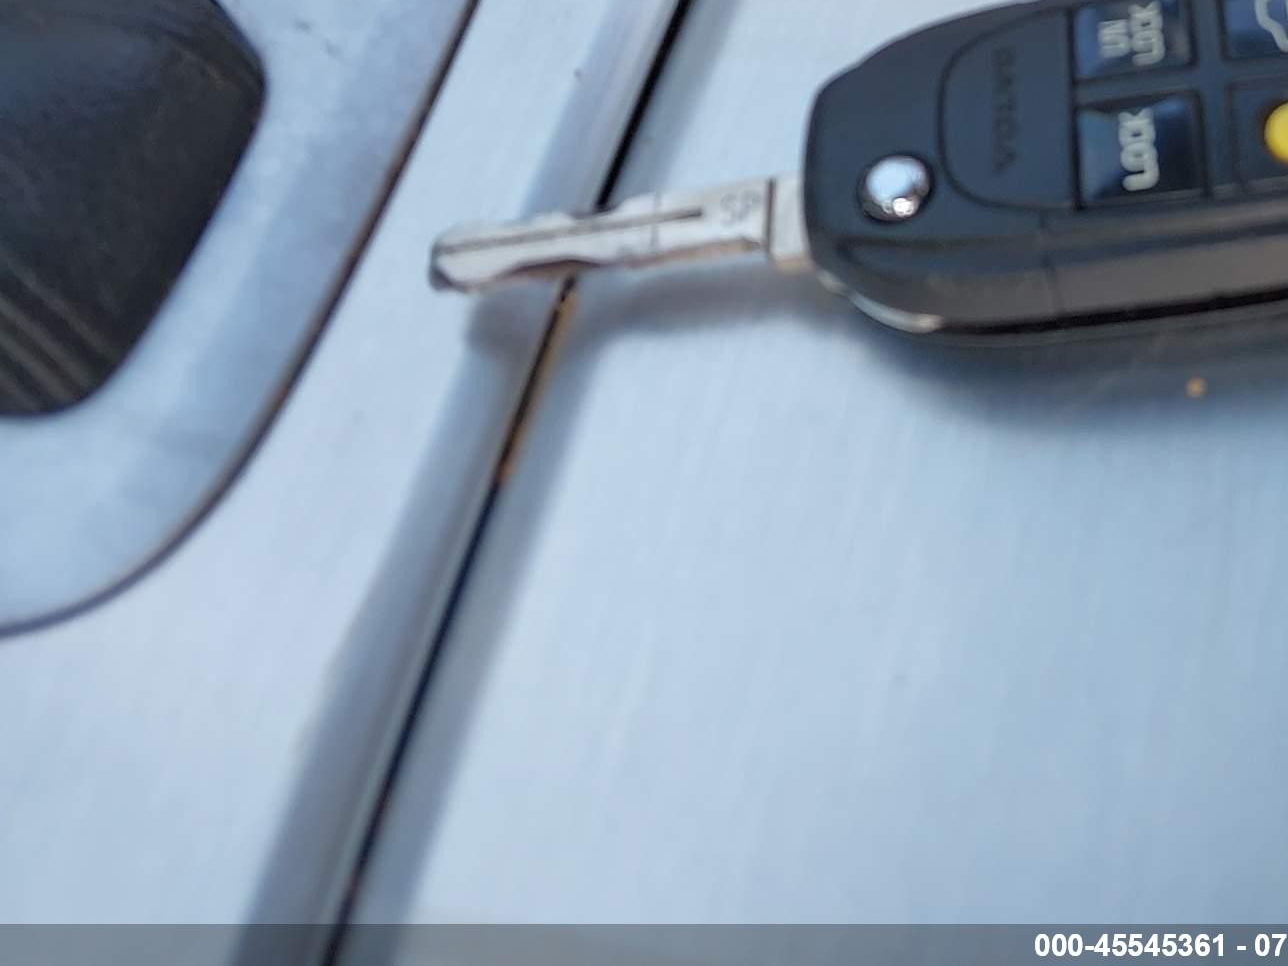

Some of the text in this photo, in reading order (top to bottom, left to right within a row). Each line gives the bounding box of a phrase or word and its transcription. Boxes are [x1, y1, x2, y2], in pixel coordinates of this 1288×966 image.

[1098, 19, 1129, 59] UN
[1128, 0, 1165, 67] LOCK
[991, 47, 1018, 174] VOLVO
[1118, 107, 1159, 192] LOCK
